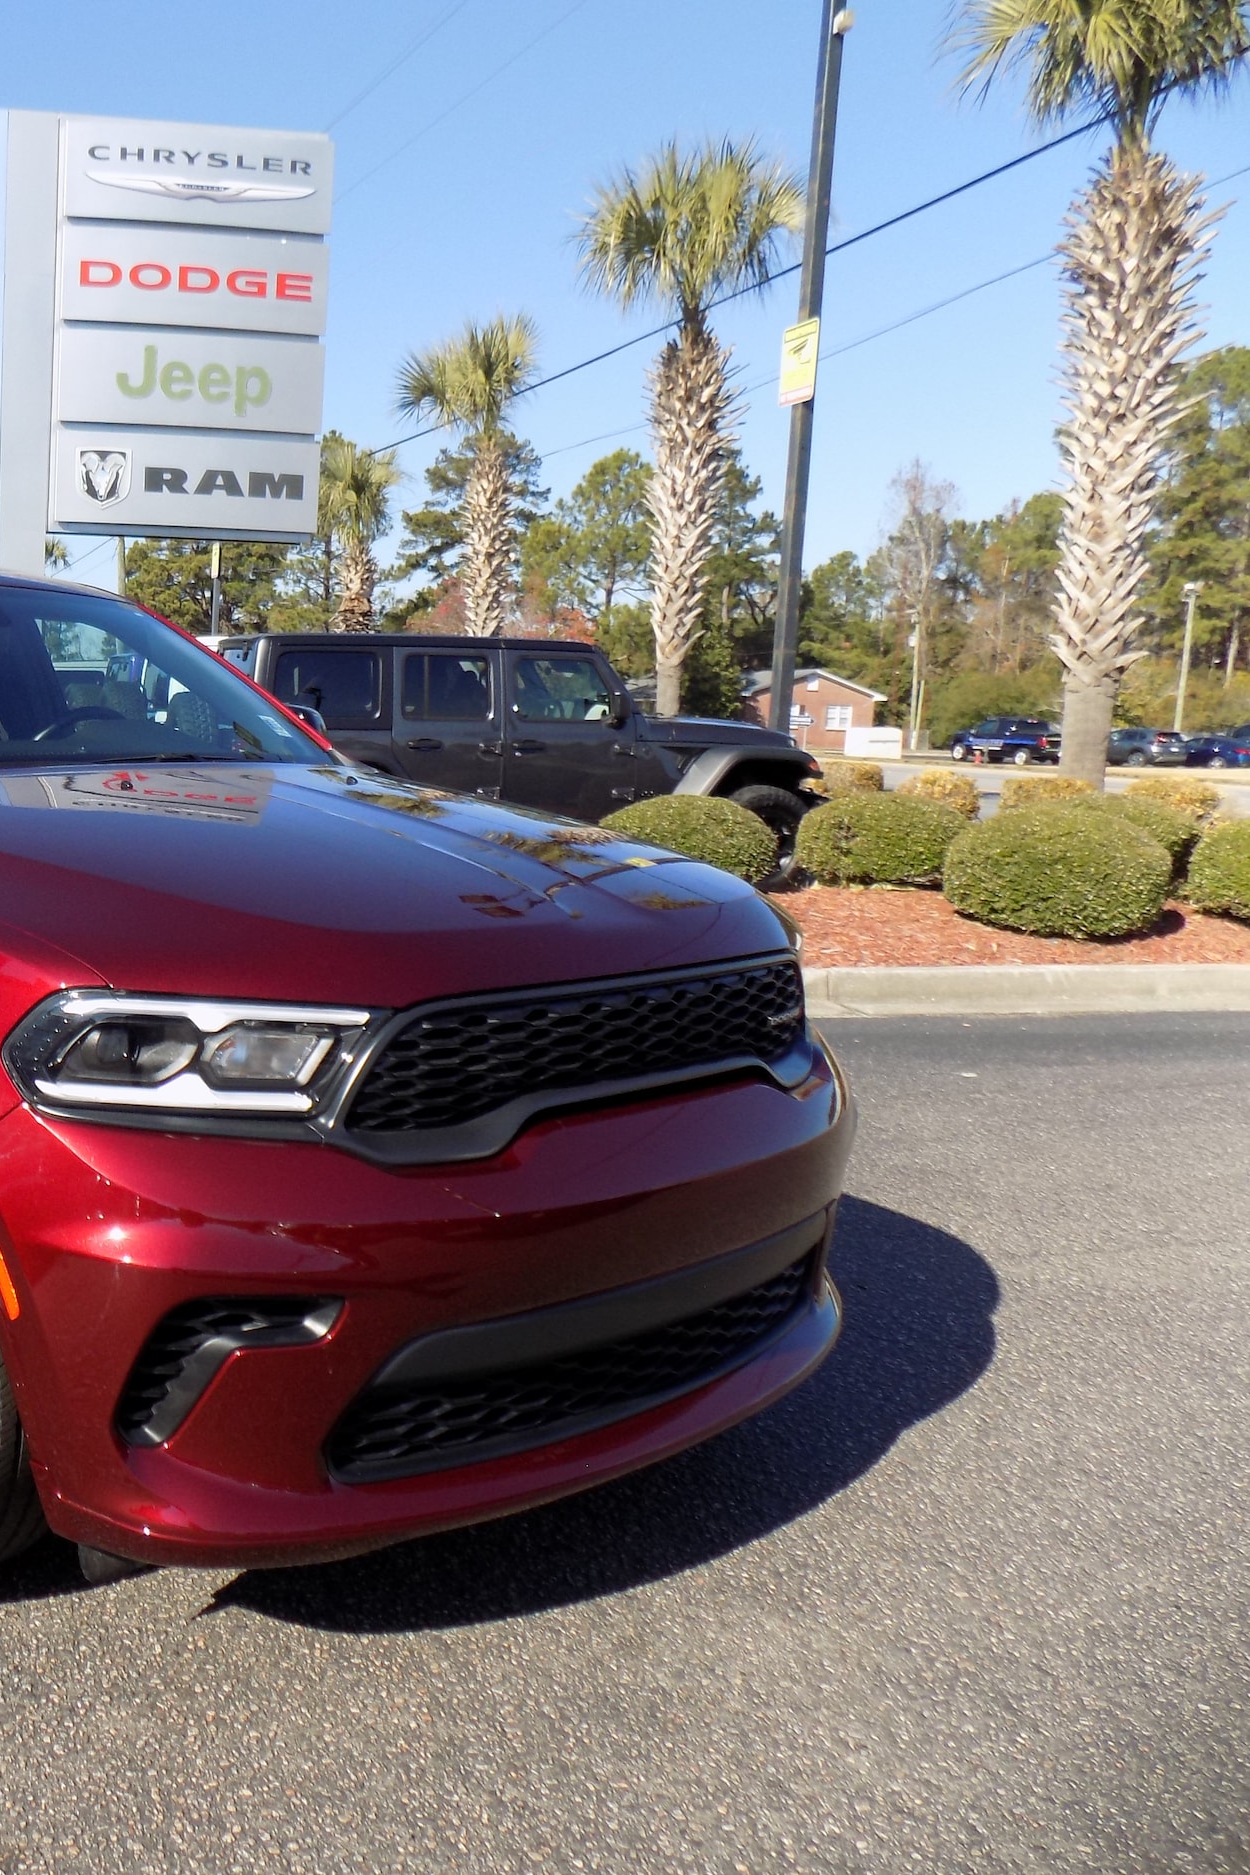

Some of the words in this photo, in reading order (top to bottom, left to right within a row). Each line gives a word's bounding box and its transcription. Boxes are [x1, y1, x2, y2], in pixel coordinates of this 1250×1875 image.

[88, 145, 312, 176] CHRYSLER
[79, 260, 313, 303] DODGE
[116, 345, 272, 417] Jeep
[144, 466, 304, 501] RAM
